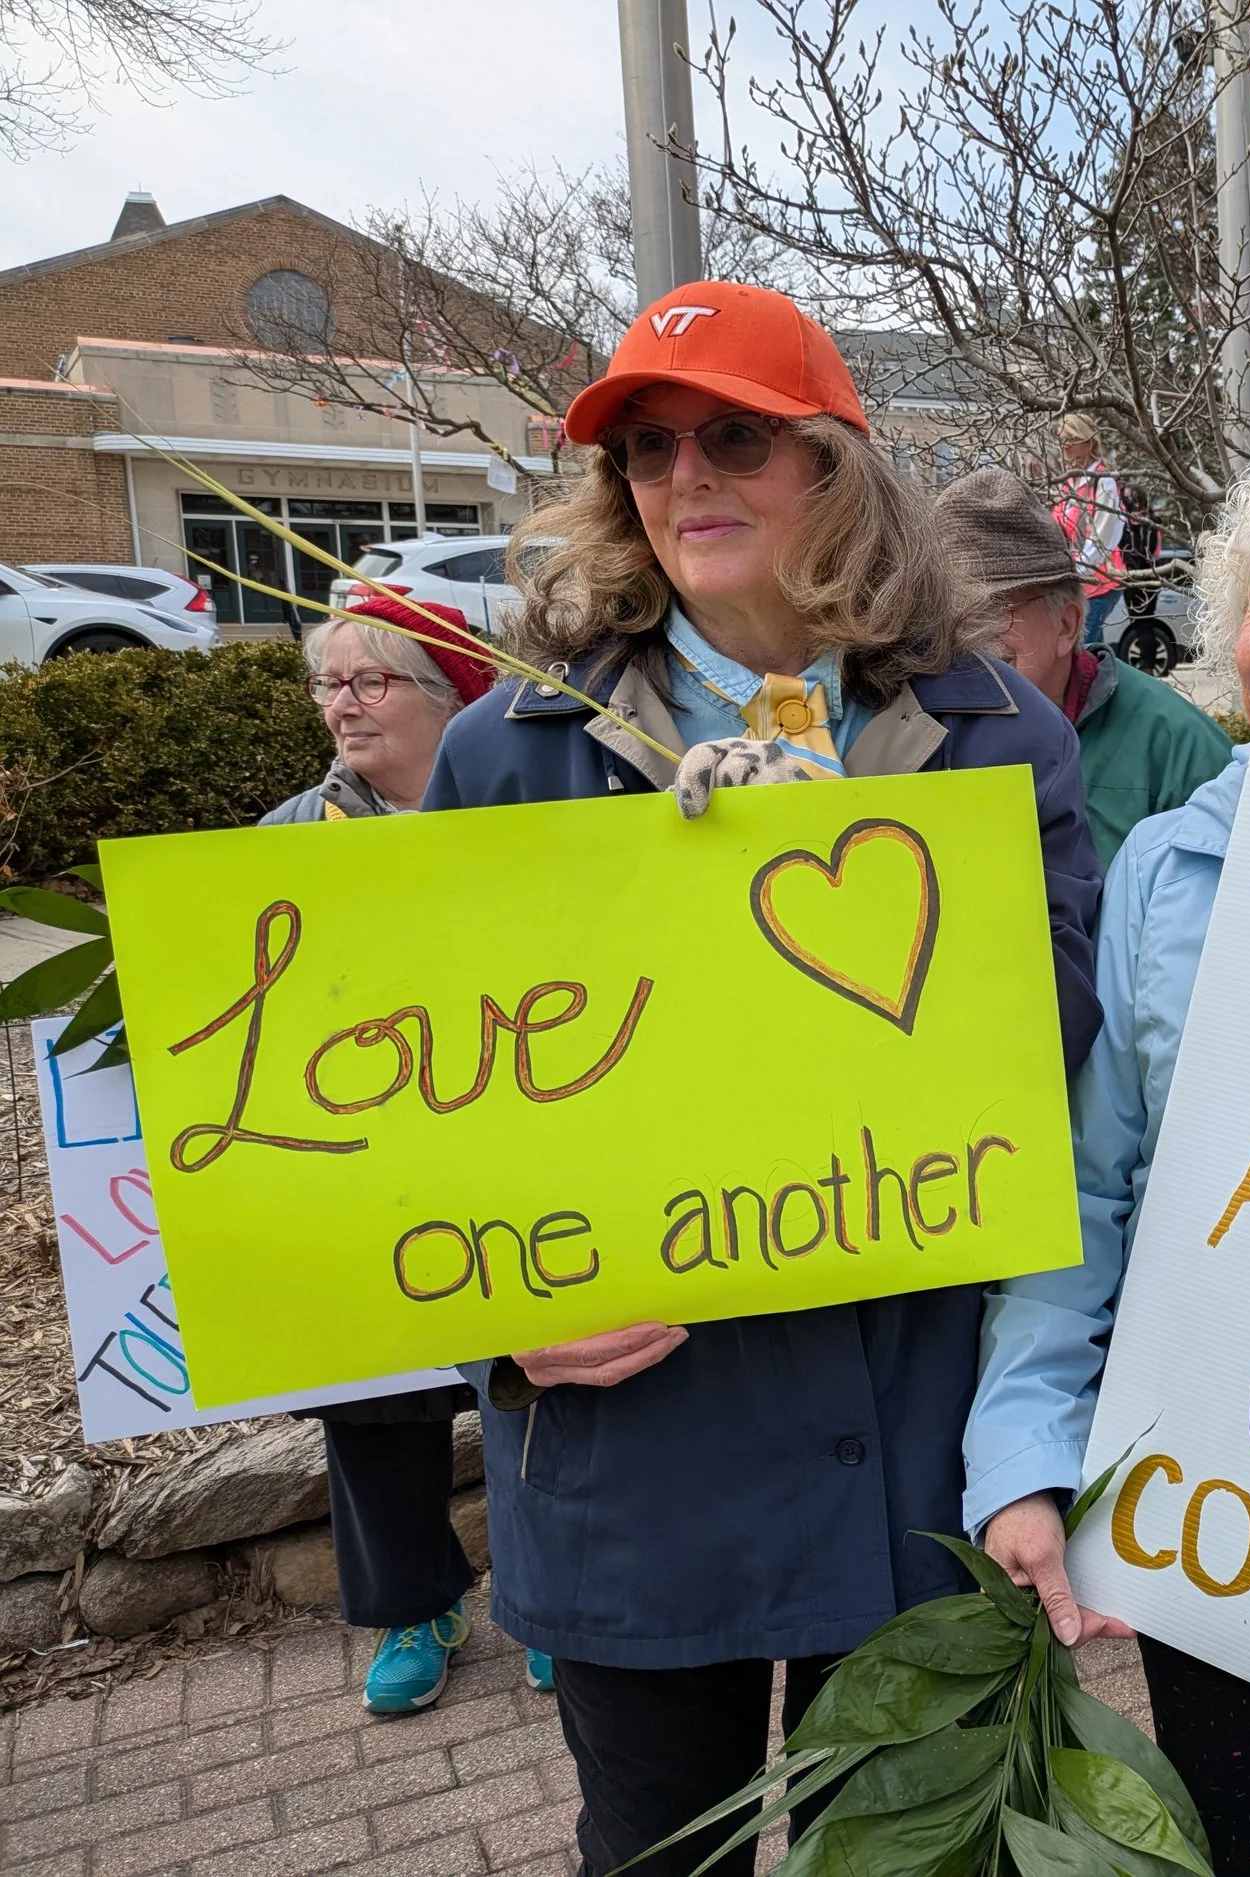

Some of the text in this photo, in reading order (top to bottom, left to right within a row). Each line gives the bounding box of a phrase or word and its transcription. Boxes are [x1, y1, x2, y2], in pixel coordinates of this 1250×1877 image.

[649, 304, 722, 341] VT
[237, 467, 440, 494] GYMNASIUM
[166, 898, 655, 1175] Love
[60, 1167, 160, 1265] LO
[393, 1124, 1019, 1303] one another
